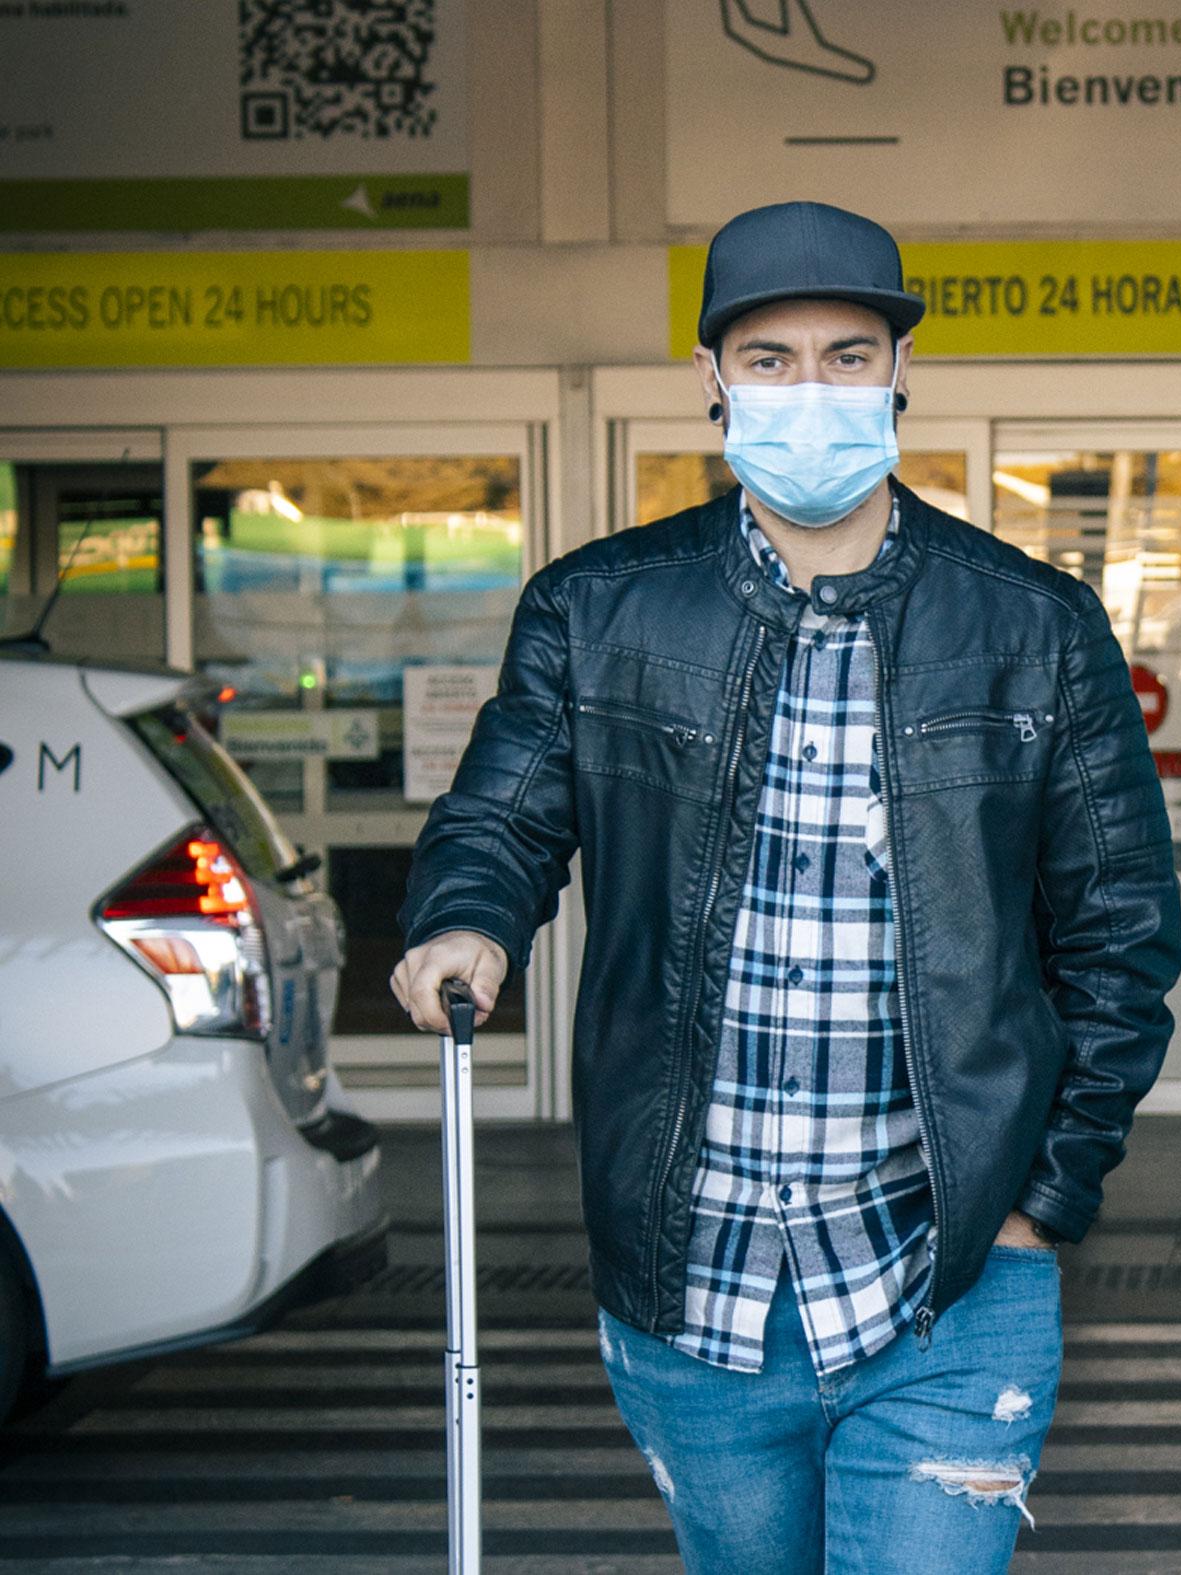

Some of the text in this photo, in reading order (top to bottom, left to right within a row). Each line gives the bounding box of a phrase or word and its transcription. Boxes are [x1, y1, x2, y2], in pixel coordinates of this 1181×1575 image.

[102, 285, 192, 329] OPEN
[204, 284, 244, 328] 24
[256, 283, 373, 328] HOURS
[1039, 275, 1078, 316] 24
[38, 742, 80, 792] M
